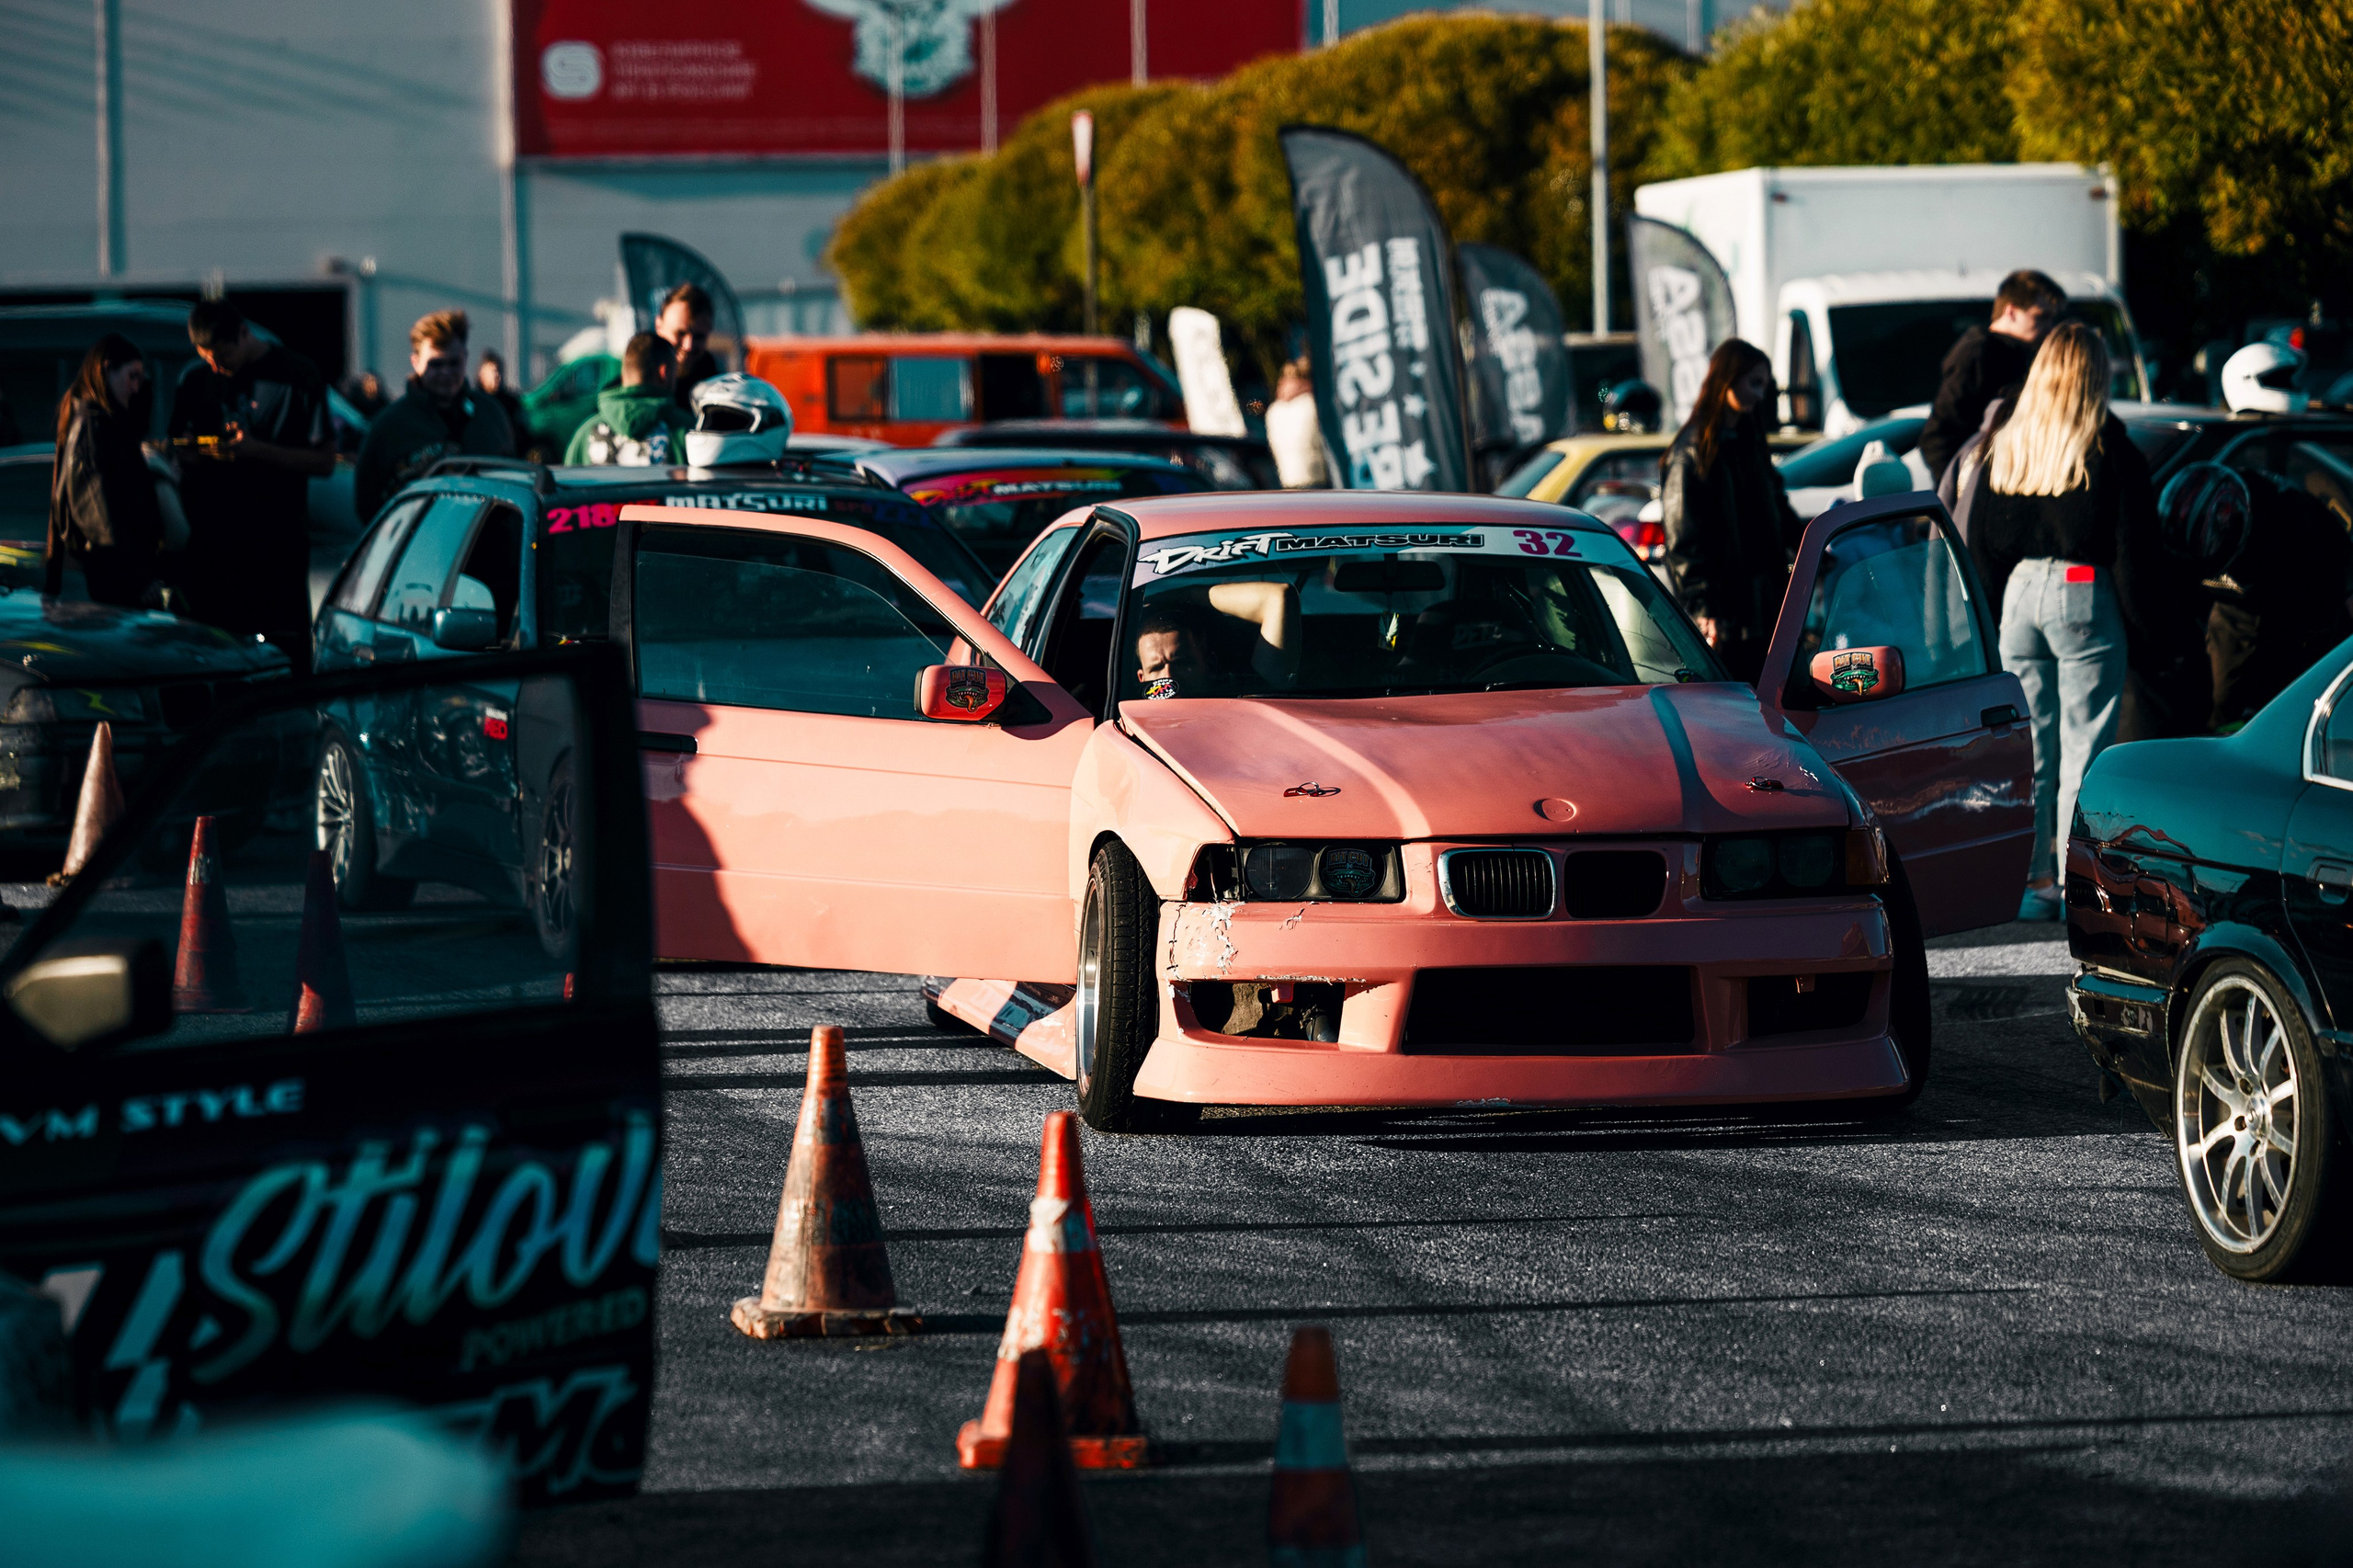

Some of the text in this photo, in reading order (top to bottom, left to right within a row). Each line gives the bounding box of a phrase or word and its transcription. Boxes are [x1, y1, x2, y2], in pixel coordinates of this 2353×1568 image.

[548, 504, 618, 534] 218
[1275, 532, 1484, 551] MATSURI
[1513, 529, 1583, 559] 32
[119, 1077, 305, 1134] STYLE
